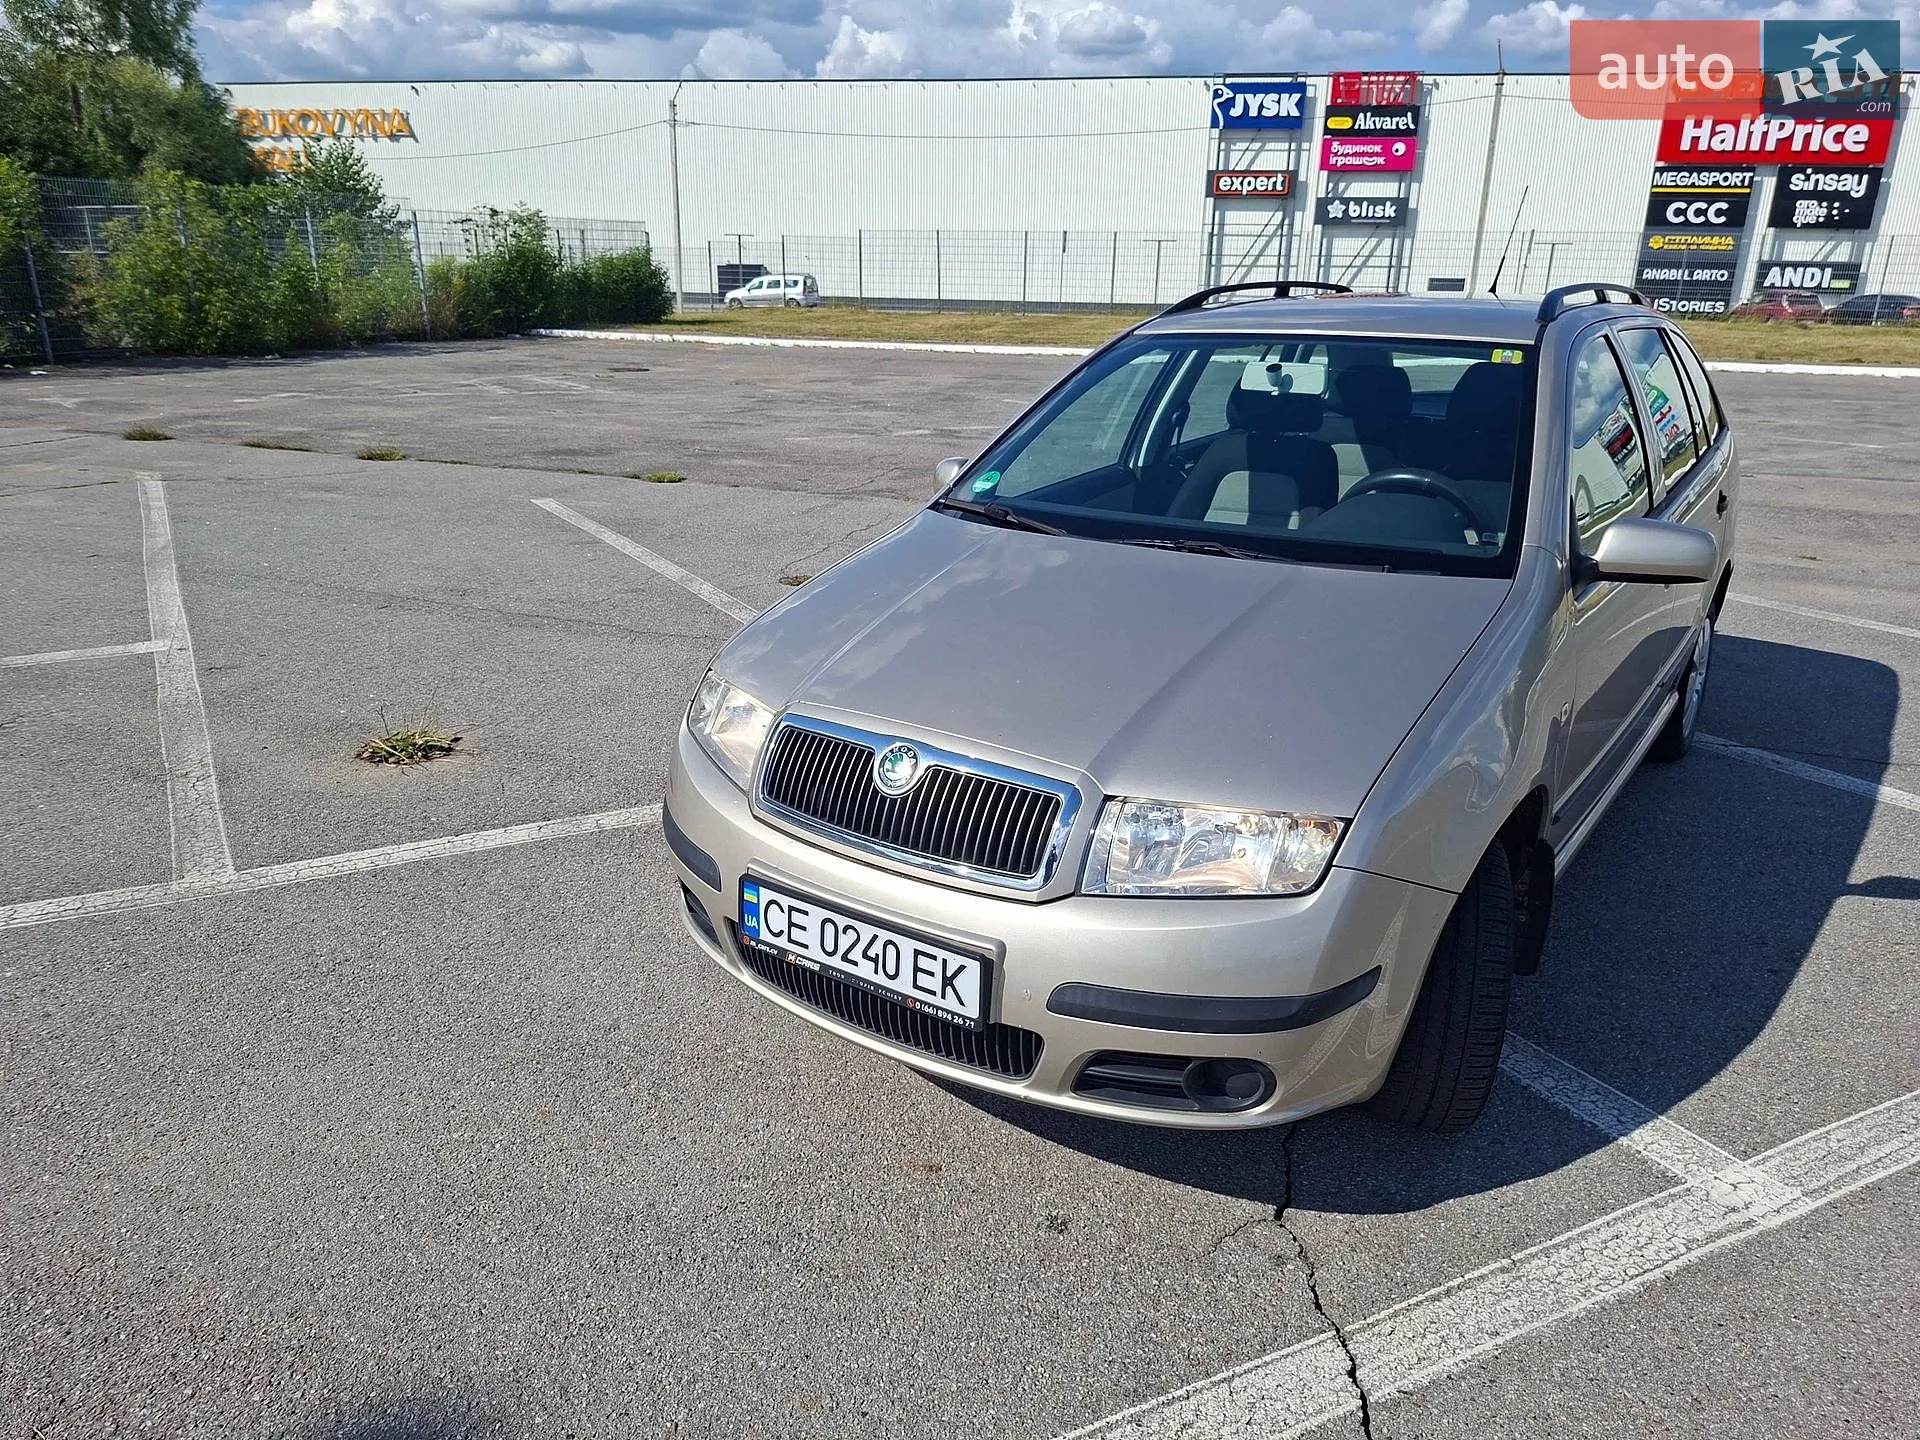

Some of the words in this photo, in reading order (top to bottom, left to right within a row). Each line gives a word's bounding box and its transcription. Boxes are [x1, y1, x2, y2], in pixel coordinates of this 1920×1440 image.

[1229, 92, 1302, 117] JYSK
[235, 107, 411, 137] BUKOVYNA
[1354, 111, 1416, 130] Akvarel
[1679, 113, 1869, 152] HalfPrice
[1331, 140, 1382, 155] будинок
[1218, 173, 1284, 195] expert
[1653, 171, 1753, 187] MEGASPORT
[1789, 168, 1869, 198] sinsay
[1348, 200, 1397, 218] blisk
[1666, 201, 1729, 224] CCC
[1693, 269, 1728, 281] ARTO
[1763, 266, 1832, 288] ANDI
[744, 913, 759, 930] UA
[763, 899, 809, 950] CE
[820, 917, 901, 980] 0240
[912, 948, 967, 1008] EK
[796, 957, 821, 971] CARS
[915, 1001, 921, 1009] 0
[921, 1004, 937, 1015] (66)
[937, 1010, 952, 1021] 894
[953, 1015, 964, 1025] 26
[964, 1019, 975, 1029] 71
